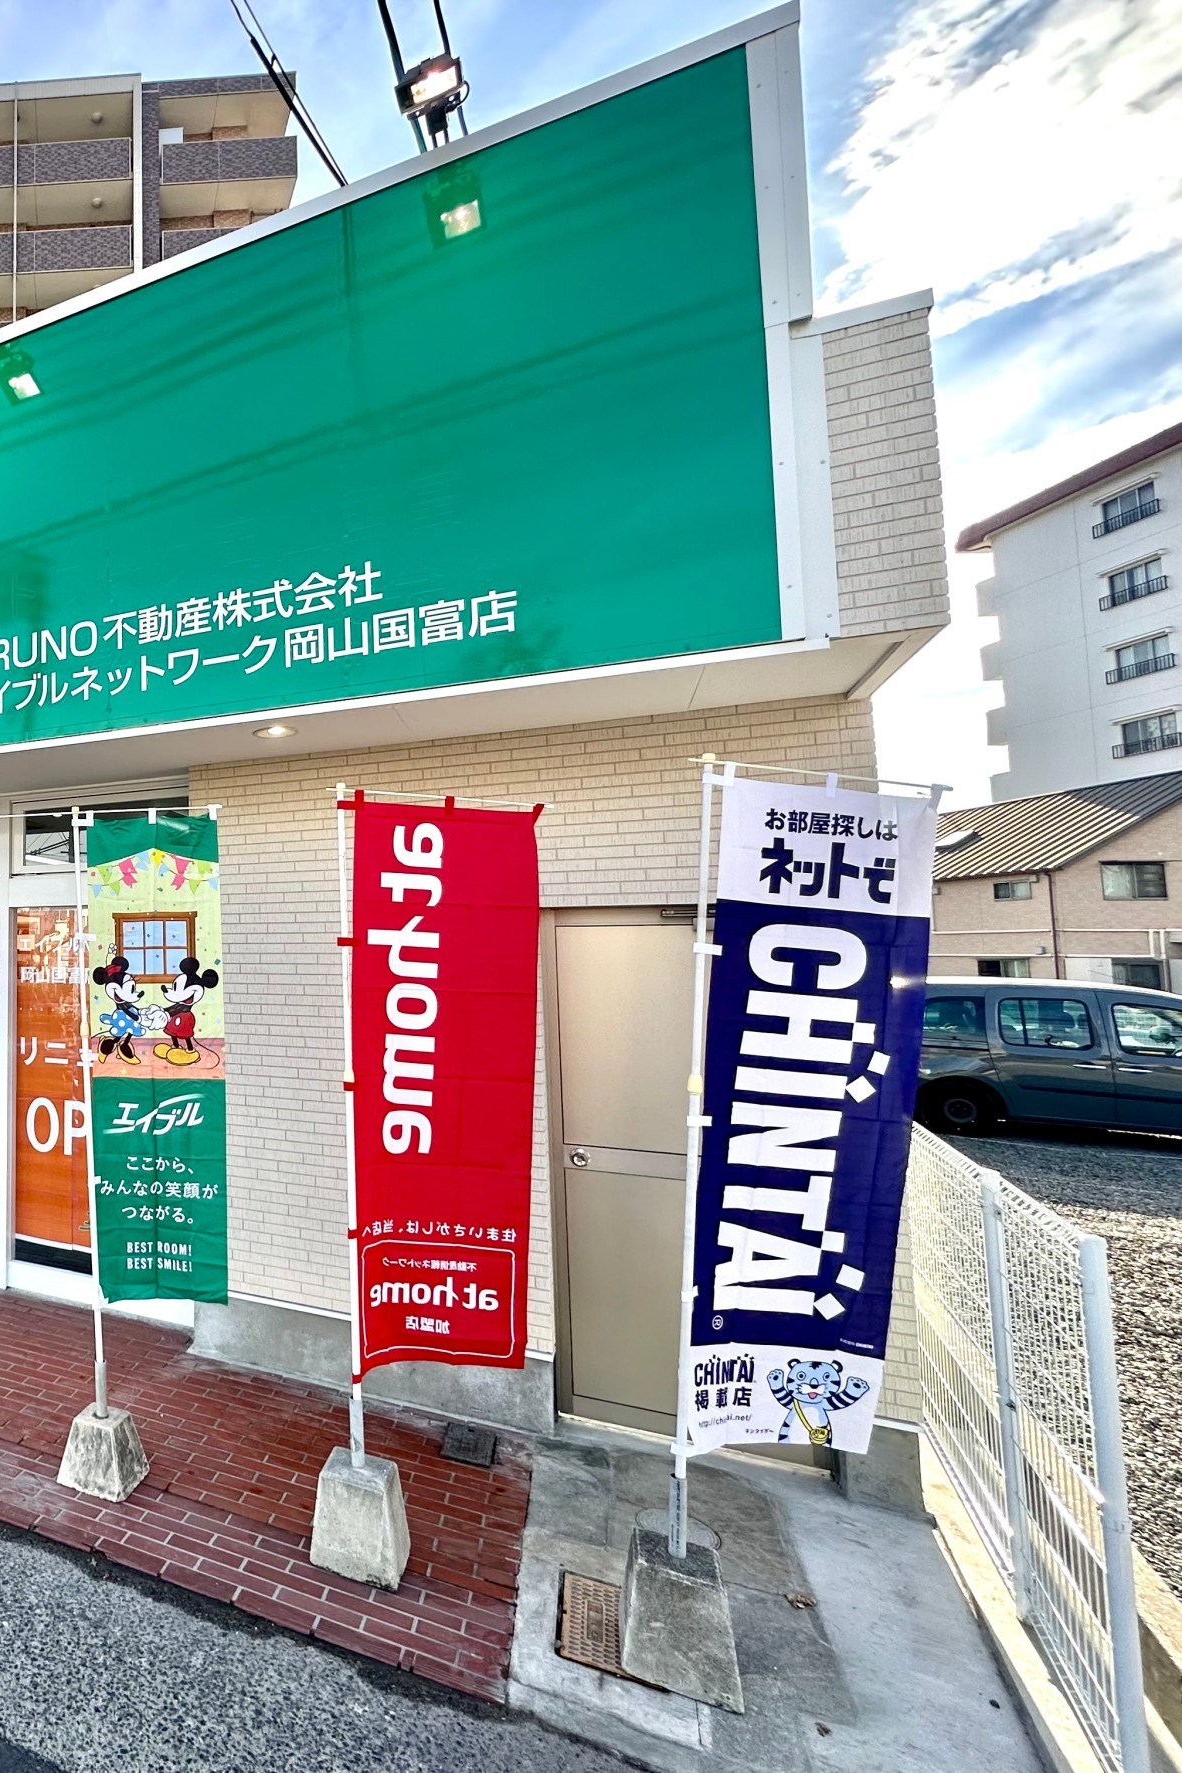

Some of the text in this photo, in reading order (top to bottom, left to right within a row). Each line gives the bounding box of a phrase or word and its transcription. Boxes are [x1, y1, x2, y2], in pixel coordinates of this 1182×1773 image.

[765, 808, 898, 841] お部屋探しは
[759, 837, 896, 904] ネットで
[21, 966, 90, 984] 岡山国富
[103, 1093, 206, 1135] エイブル
[711, 922, 891, 1318] CHINTAI
[126, 1156, 194, 1174] ここから、
[100, 1180, 218, 1199] みんなの笑顔が
[122, 1205, 193, 1224] つながる。
[127, 1241, 192, 1256] BEST ROOM!
[127, 1257, 192, 1272] BEST SMILE!
[694, 1353, 756, 1387] CHINTAI
